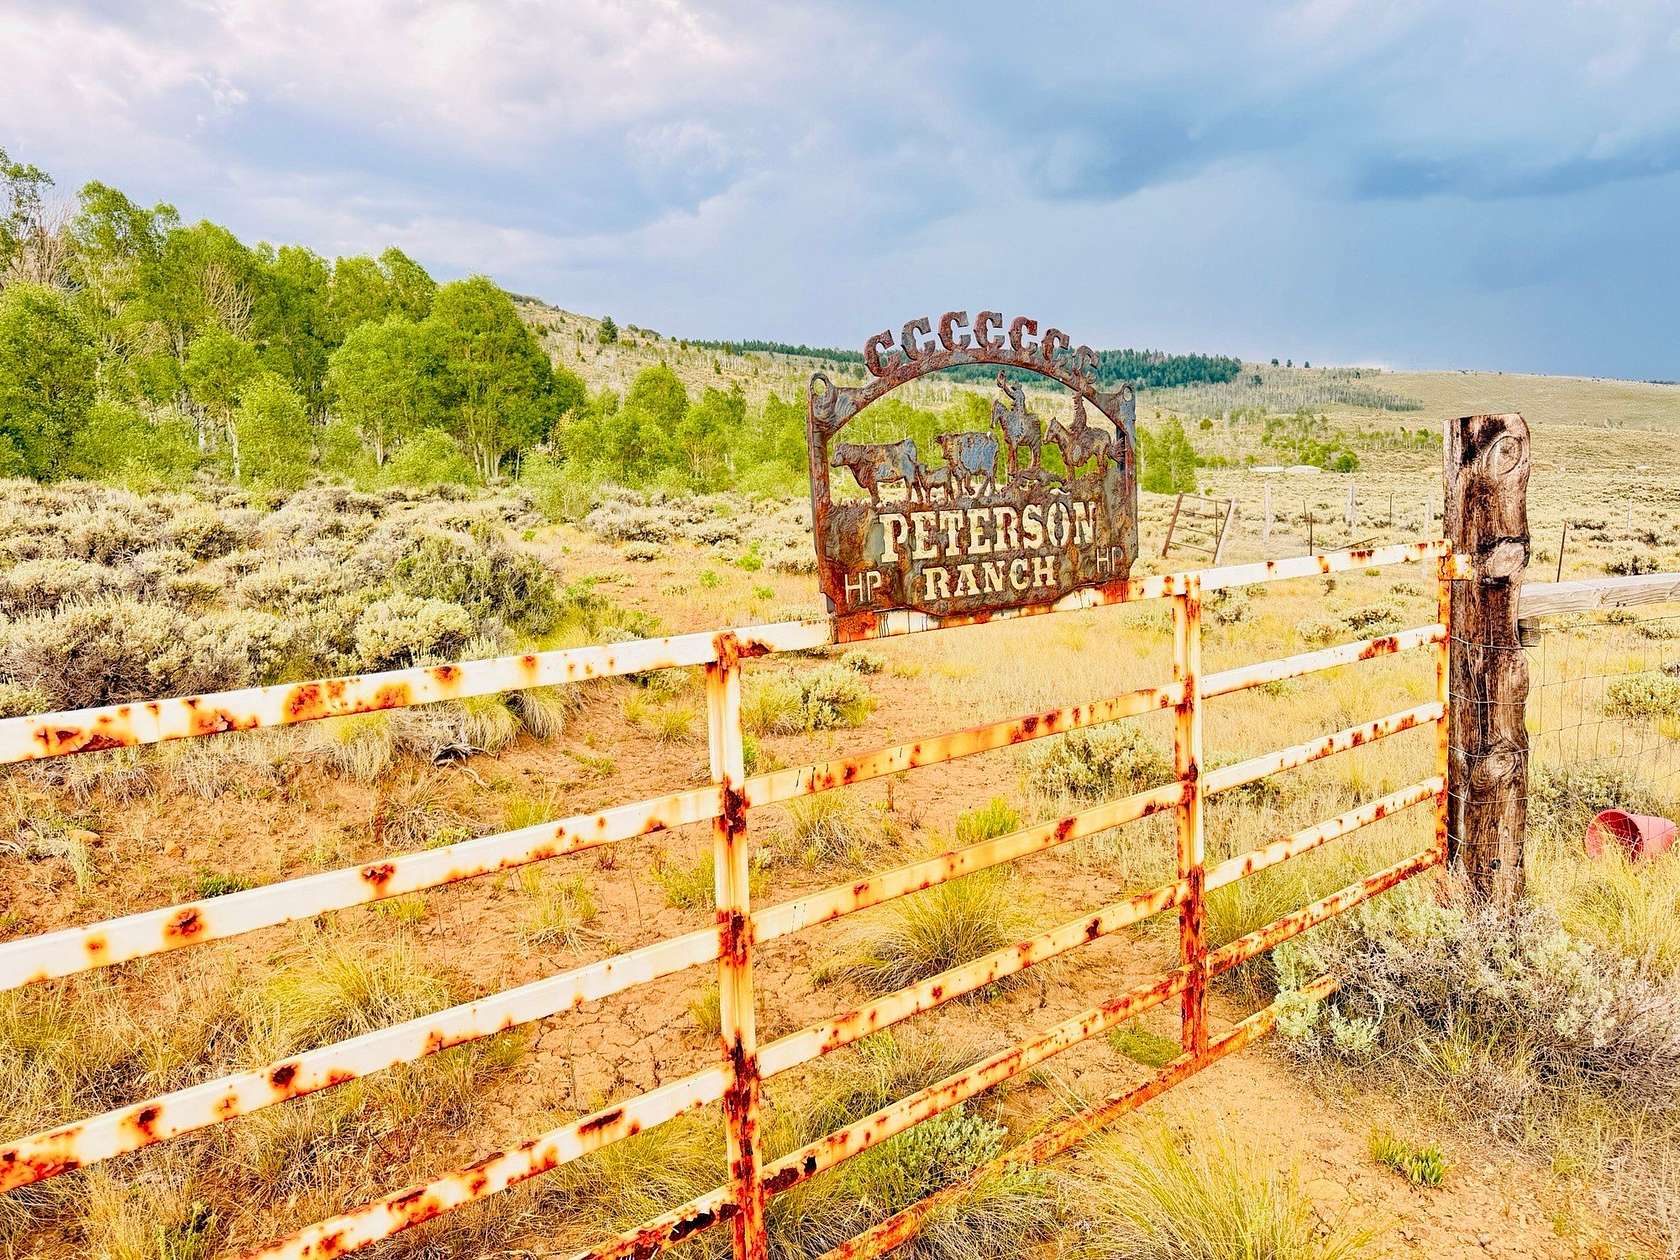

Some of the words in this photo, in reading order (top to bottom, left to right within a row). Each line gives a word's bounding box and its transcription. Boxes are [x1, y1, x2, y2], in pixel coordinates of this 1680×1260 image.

[879, 501, 1096, 563] PETERSON
[922, 555, 1057, 601] RANCH
[1096, 546, 1124, 574] HP
[845, 570, 883, 604] HP
